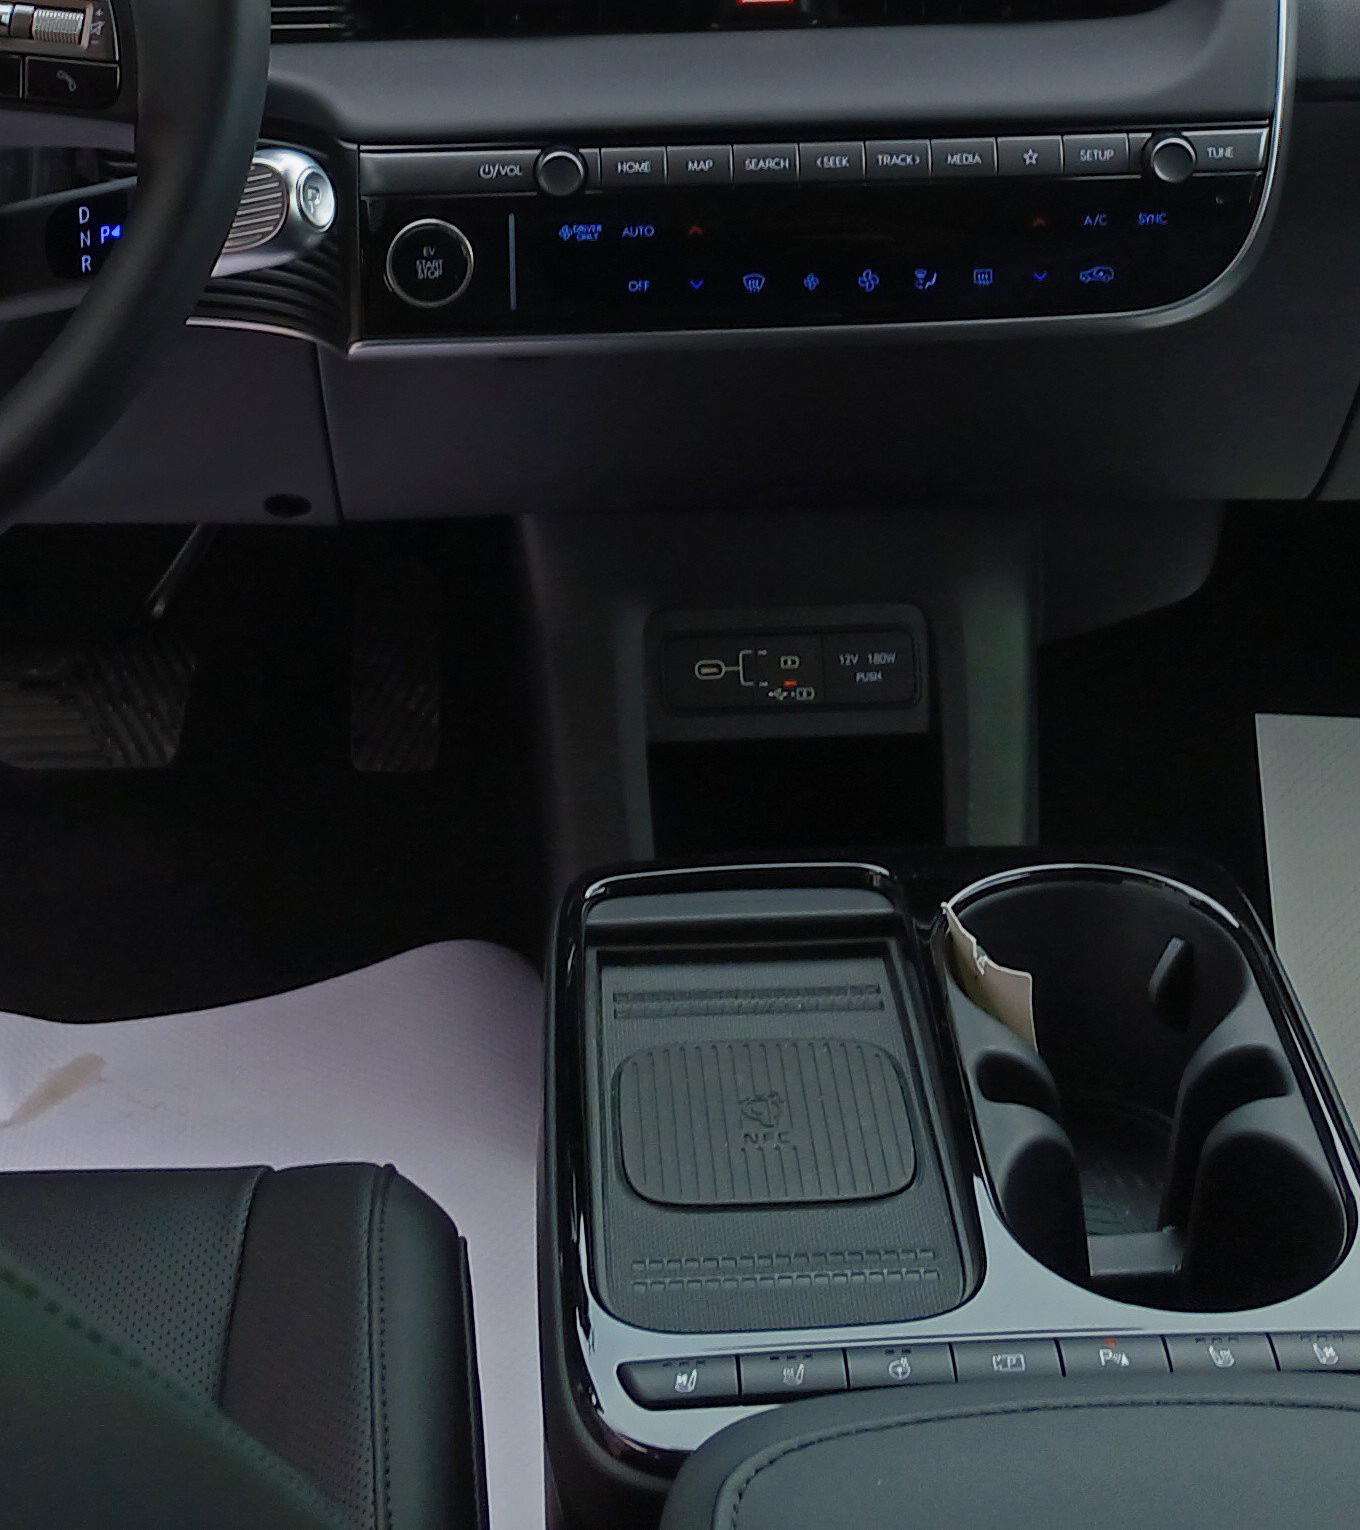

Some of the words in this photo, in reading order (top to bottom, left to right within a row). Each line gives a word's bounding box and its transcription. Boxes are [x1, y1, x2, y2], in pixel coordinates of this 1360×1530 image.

[616, 160, 652, 174] HOME
[687, 159, 714, 172] MAP
[744, 157, 790, 172] SEARCH
[946, 152, 982, 166] MEDIA
[1078, 148, 1115, 162] SETUP
[1206, 145, 1234, 160] TUNE
[79, 206, 90, 224] D
[1083, 212, 1108, 227] A/C
[1138, 211, 1168, 226] SYNC
[80, 230, 90, 248] N
[100, 226, 110, 243] P
[621, 224, 655, 238] AUTO
[422, 246, 436, 258] EV
[82, 255, 92, 272] R
[628, 280, 650, 293] OFF
[840, 654, 859, 666] 12V
[856, 671, 883, 683] PUSH
[743, 1131, 790, 1144] NFC
